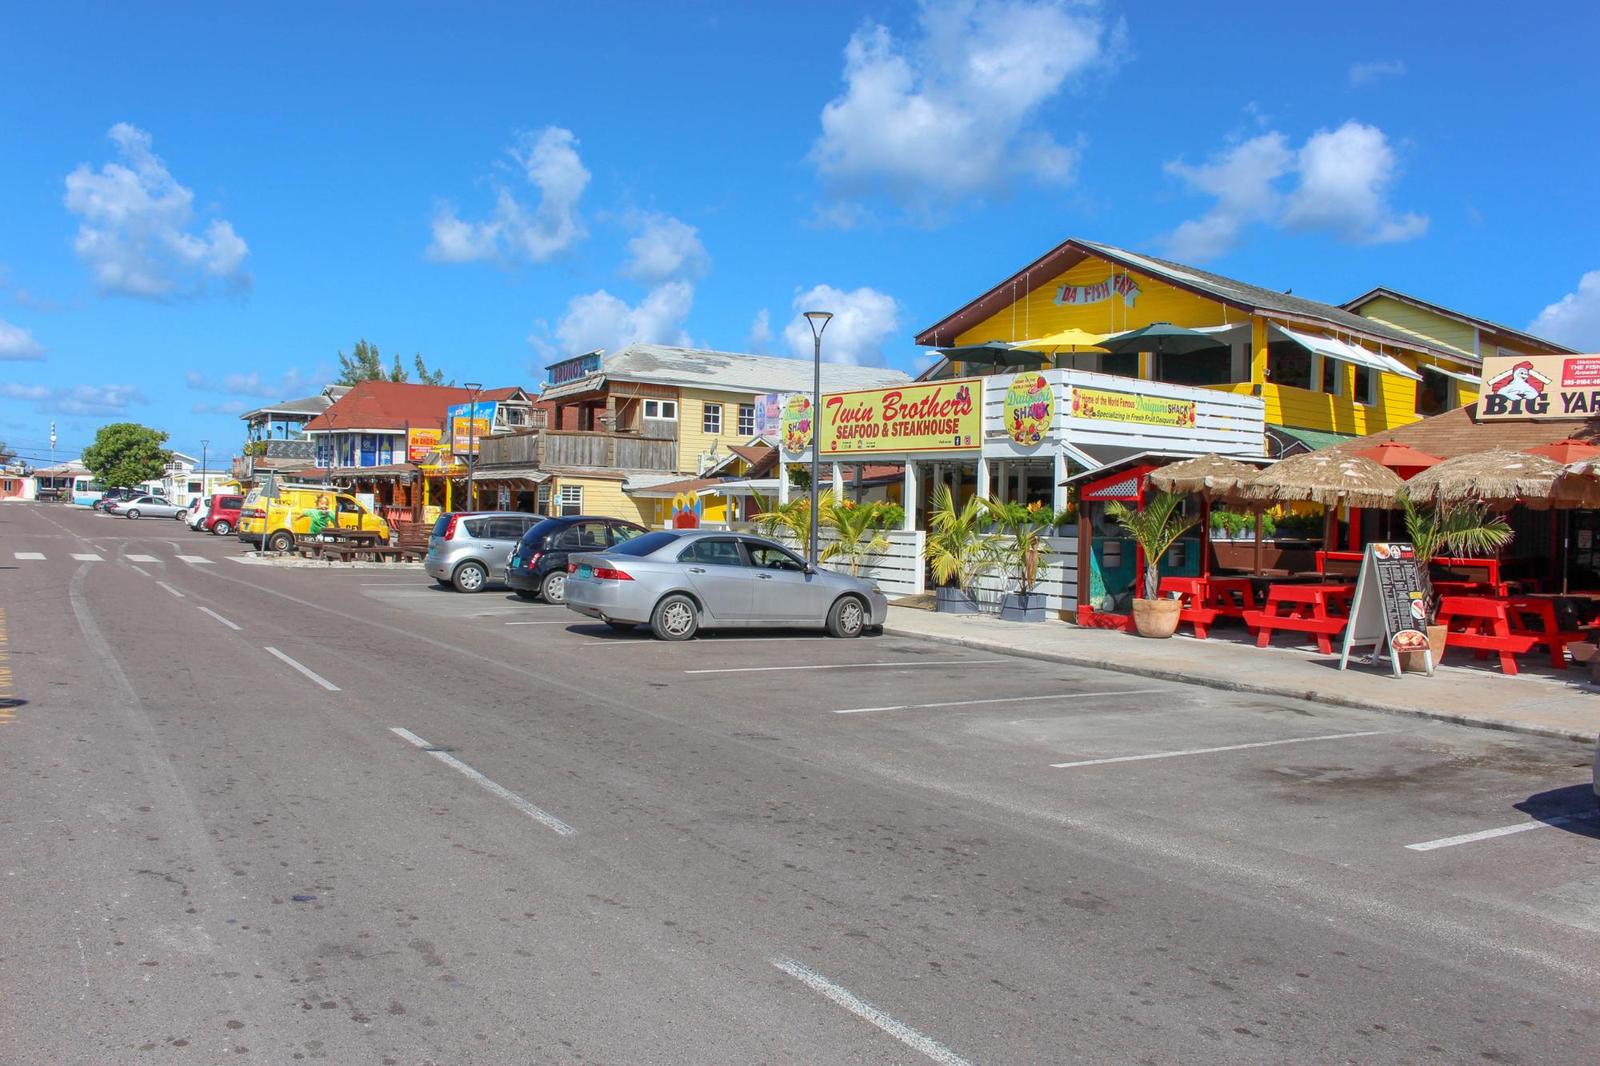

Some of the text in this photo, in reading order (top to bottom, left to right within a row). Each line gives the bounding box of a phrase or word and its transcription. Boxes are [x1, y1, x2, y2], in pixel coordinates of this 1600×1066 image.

[826, 387, 973, 426] Twin Brothers
[1107, 396, 1119, 407] World
[1119, 397, 1135, 409] Famous
[1168, 404, 1188, 415] SHACK
[1482, 392, 1550, 416] BIG
[836, 418, 960, 439] SEAFOOD & STEAKHOUSE
